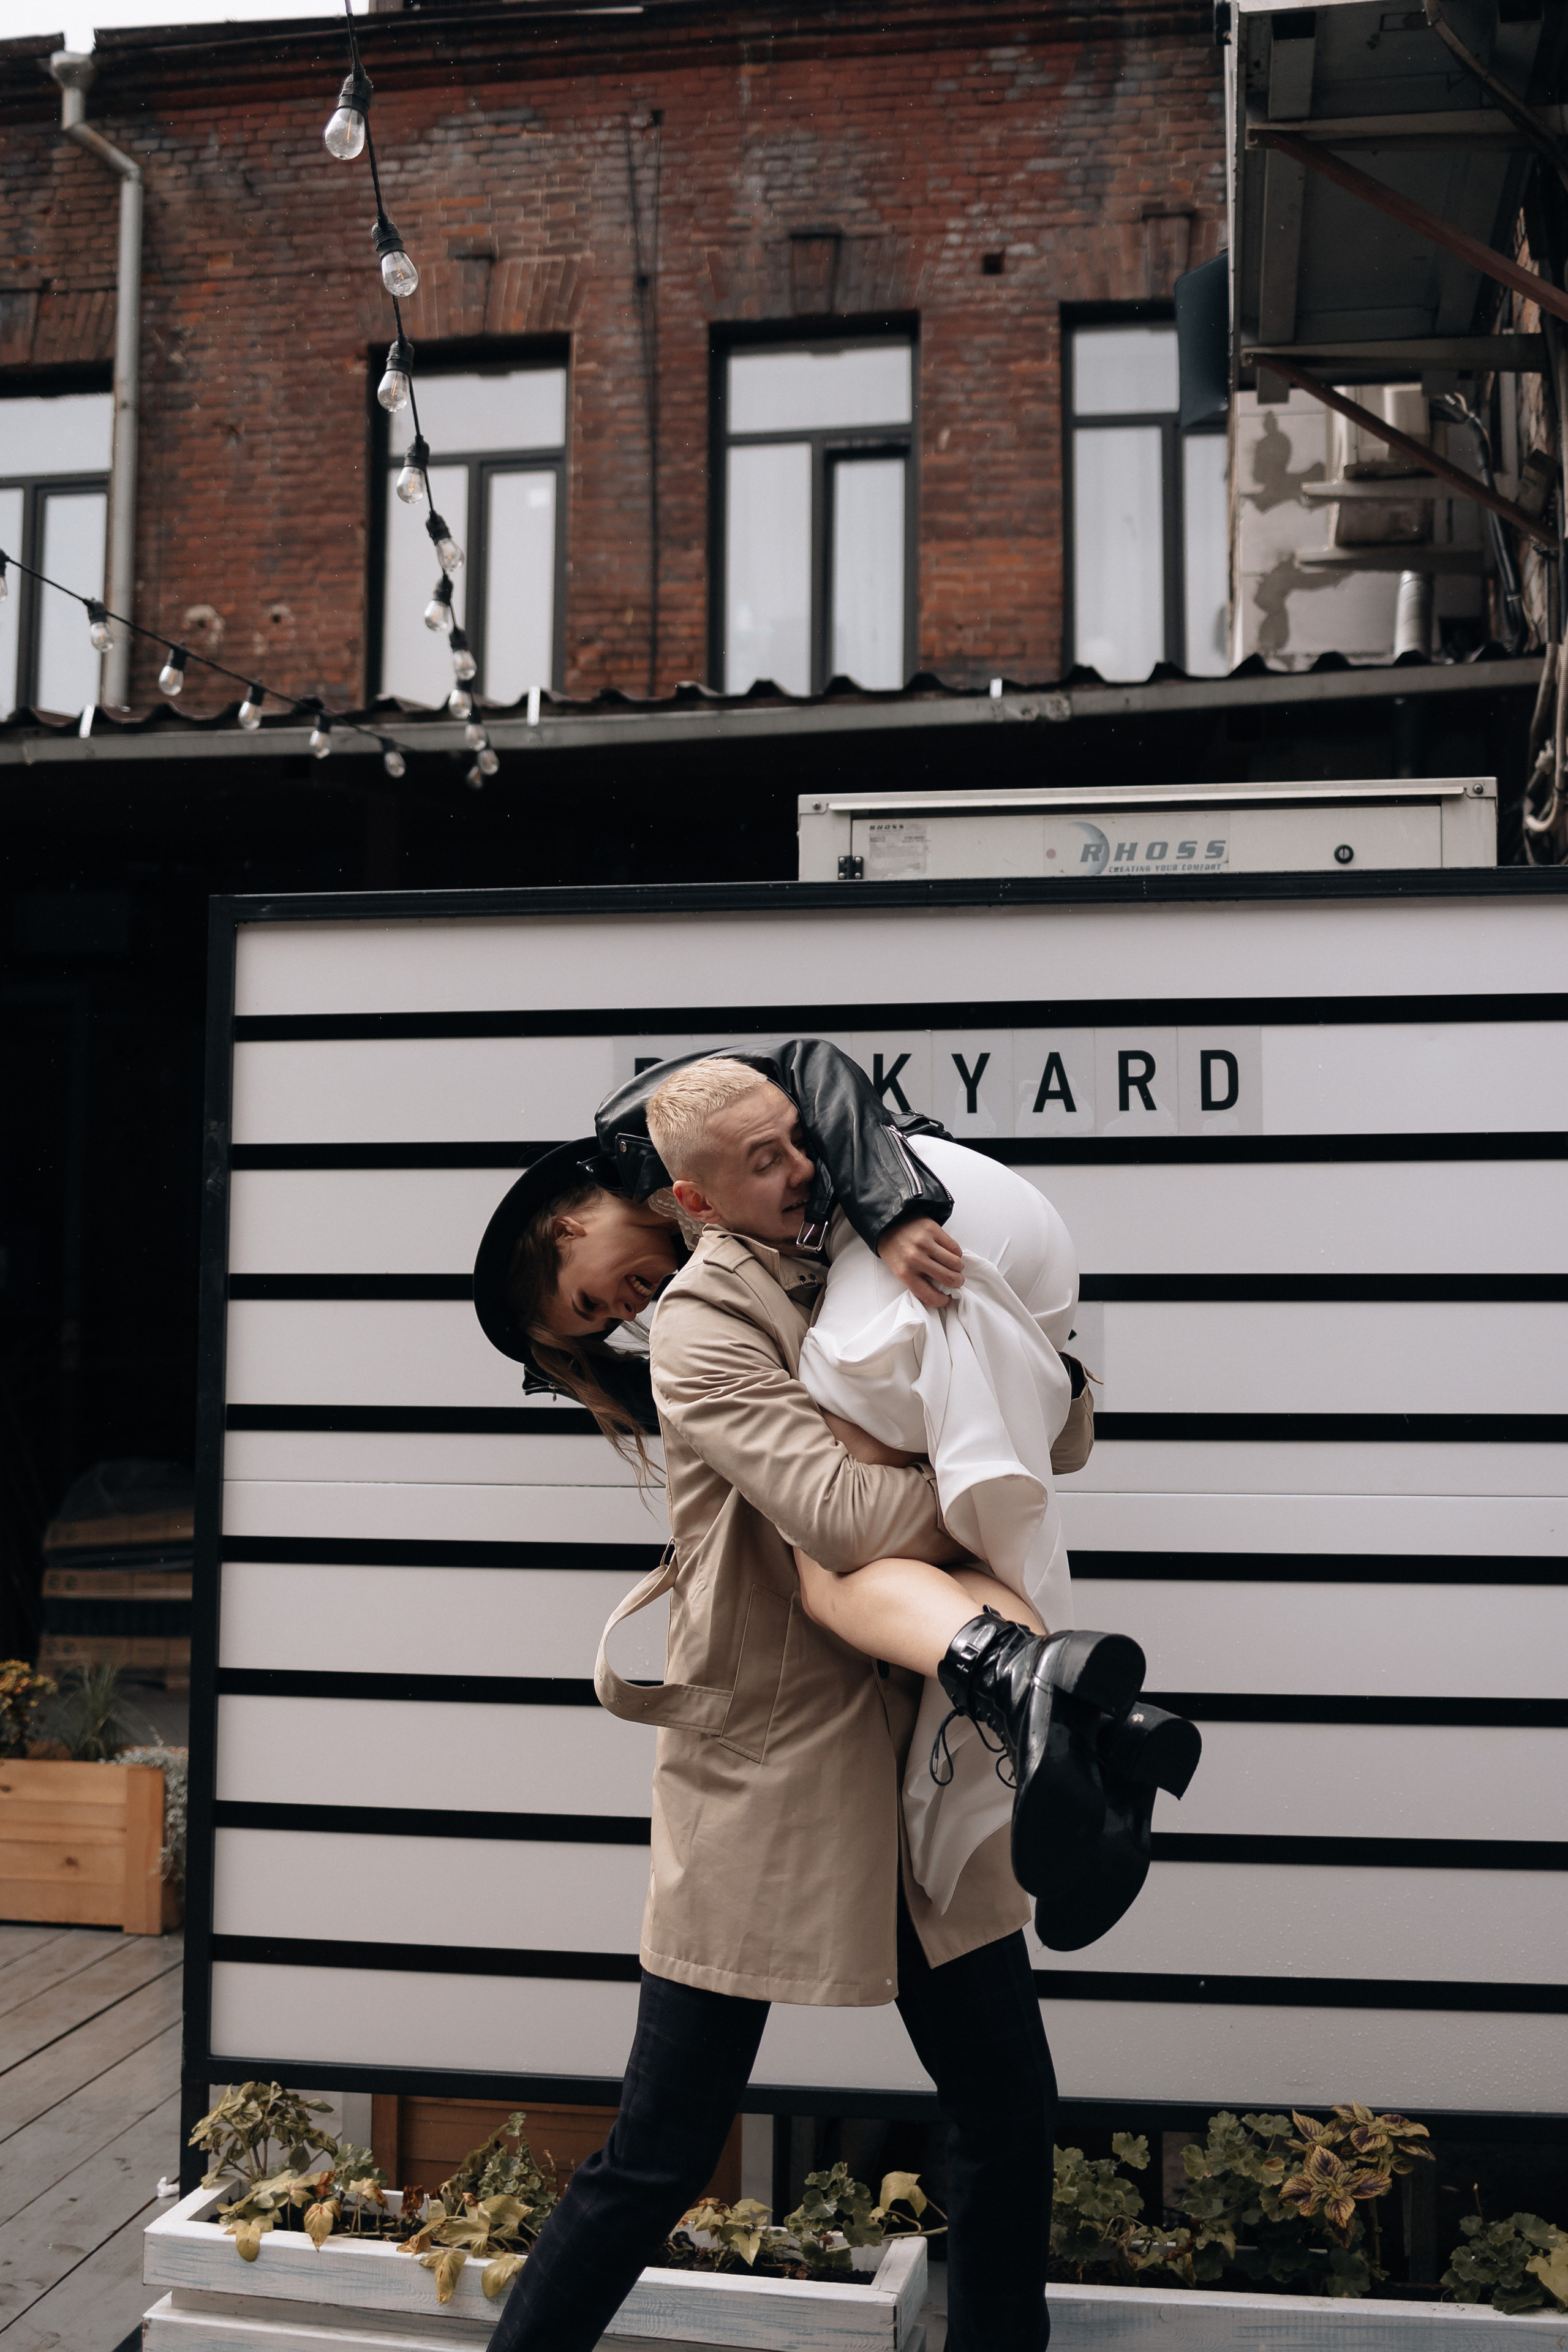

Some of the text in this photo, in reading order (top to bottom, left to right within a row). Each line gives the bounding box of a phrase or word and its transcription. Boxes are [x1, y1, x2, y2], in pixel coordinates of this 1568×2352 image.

[1079, 840, 1227, 862] RHOSS
[1109, 865, 1151, 873] CREATING
[634, 1049, 1239, 1114] KYARD
